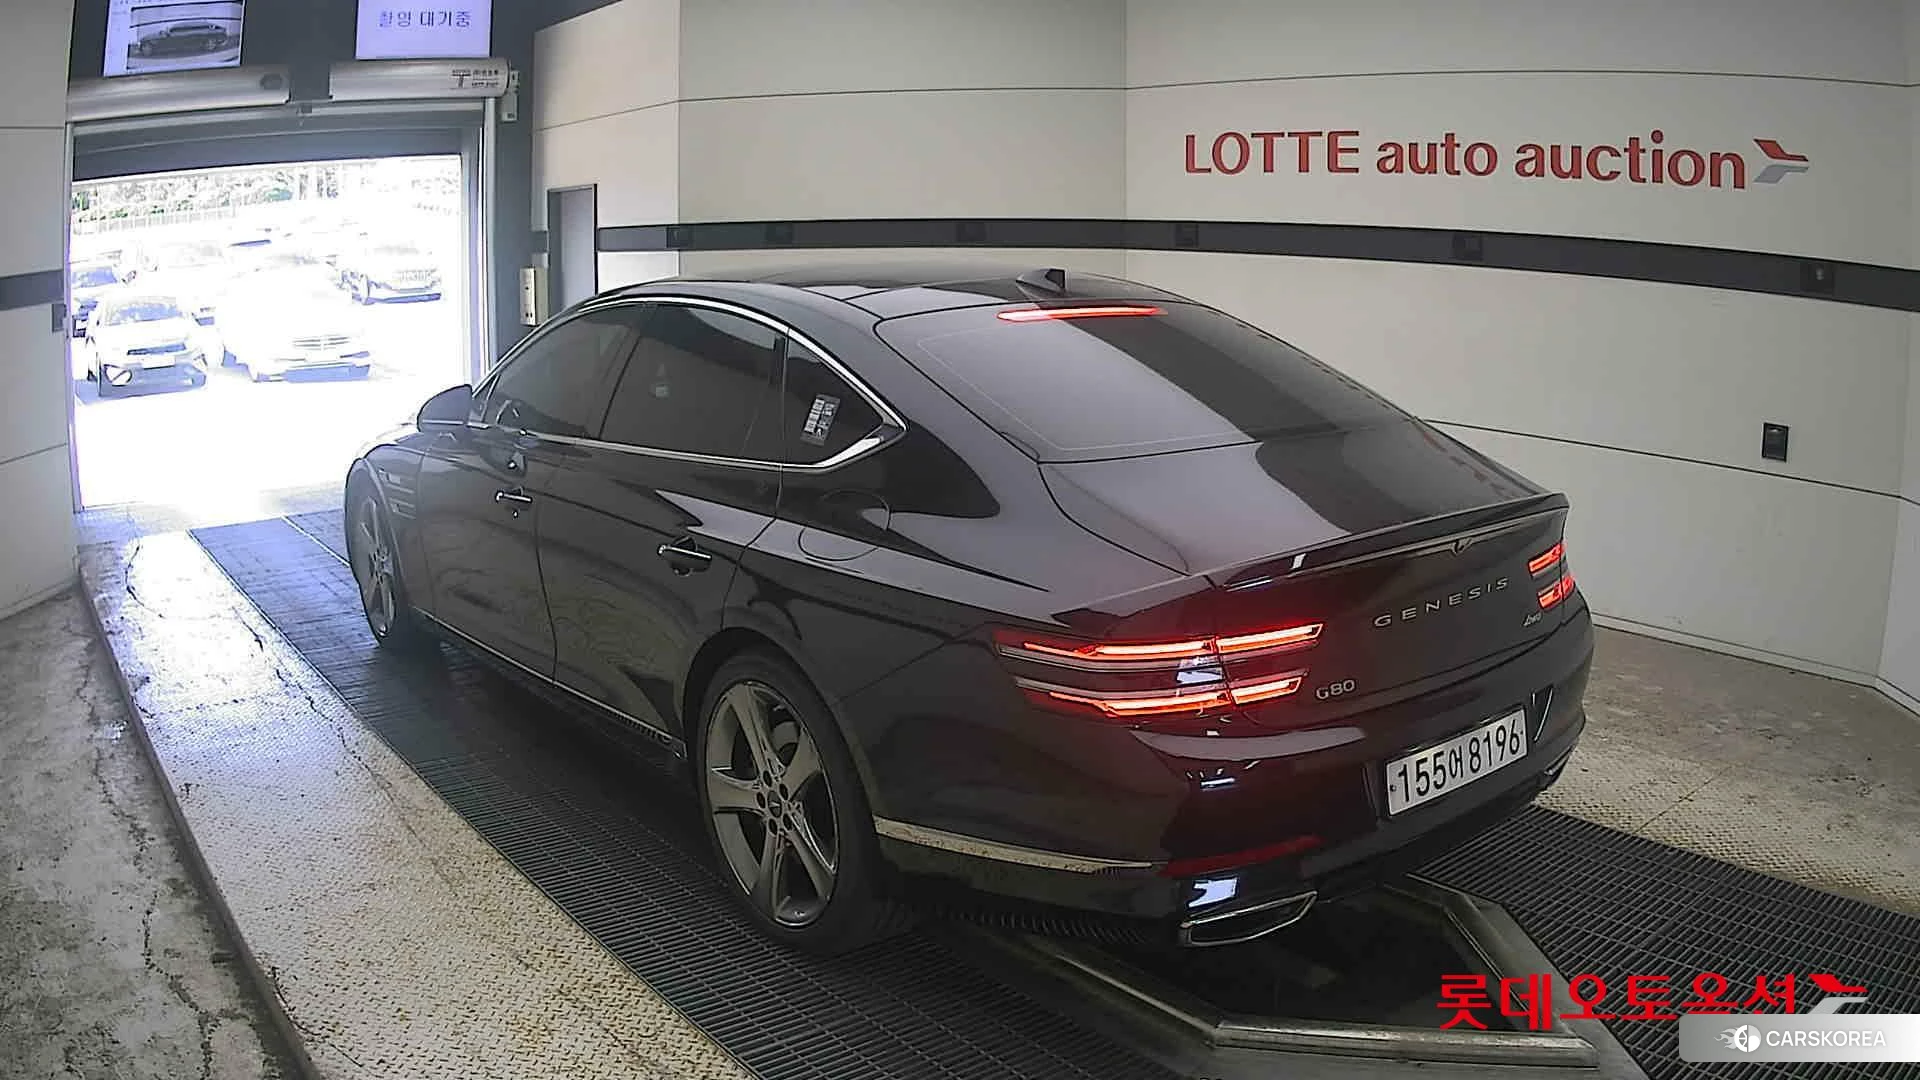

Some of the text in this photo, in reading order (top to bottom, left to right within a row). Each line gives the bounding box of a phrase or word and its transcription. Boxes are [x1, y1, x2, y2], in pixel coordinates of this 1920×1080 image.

[420, 10, 470, 28] 대기중
[1185, 129, 1746, 189] LOTTE auto auction
[1373, 576, 1510, 628] GENESIS
[1315, 679, 1356, 700] G80
